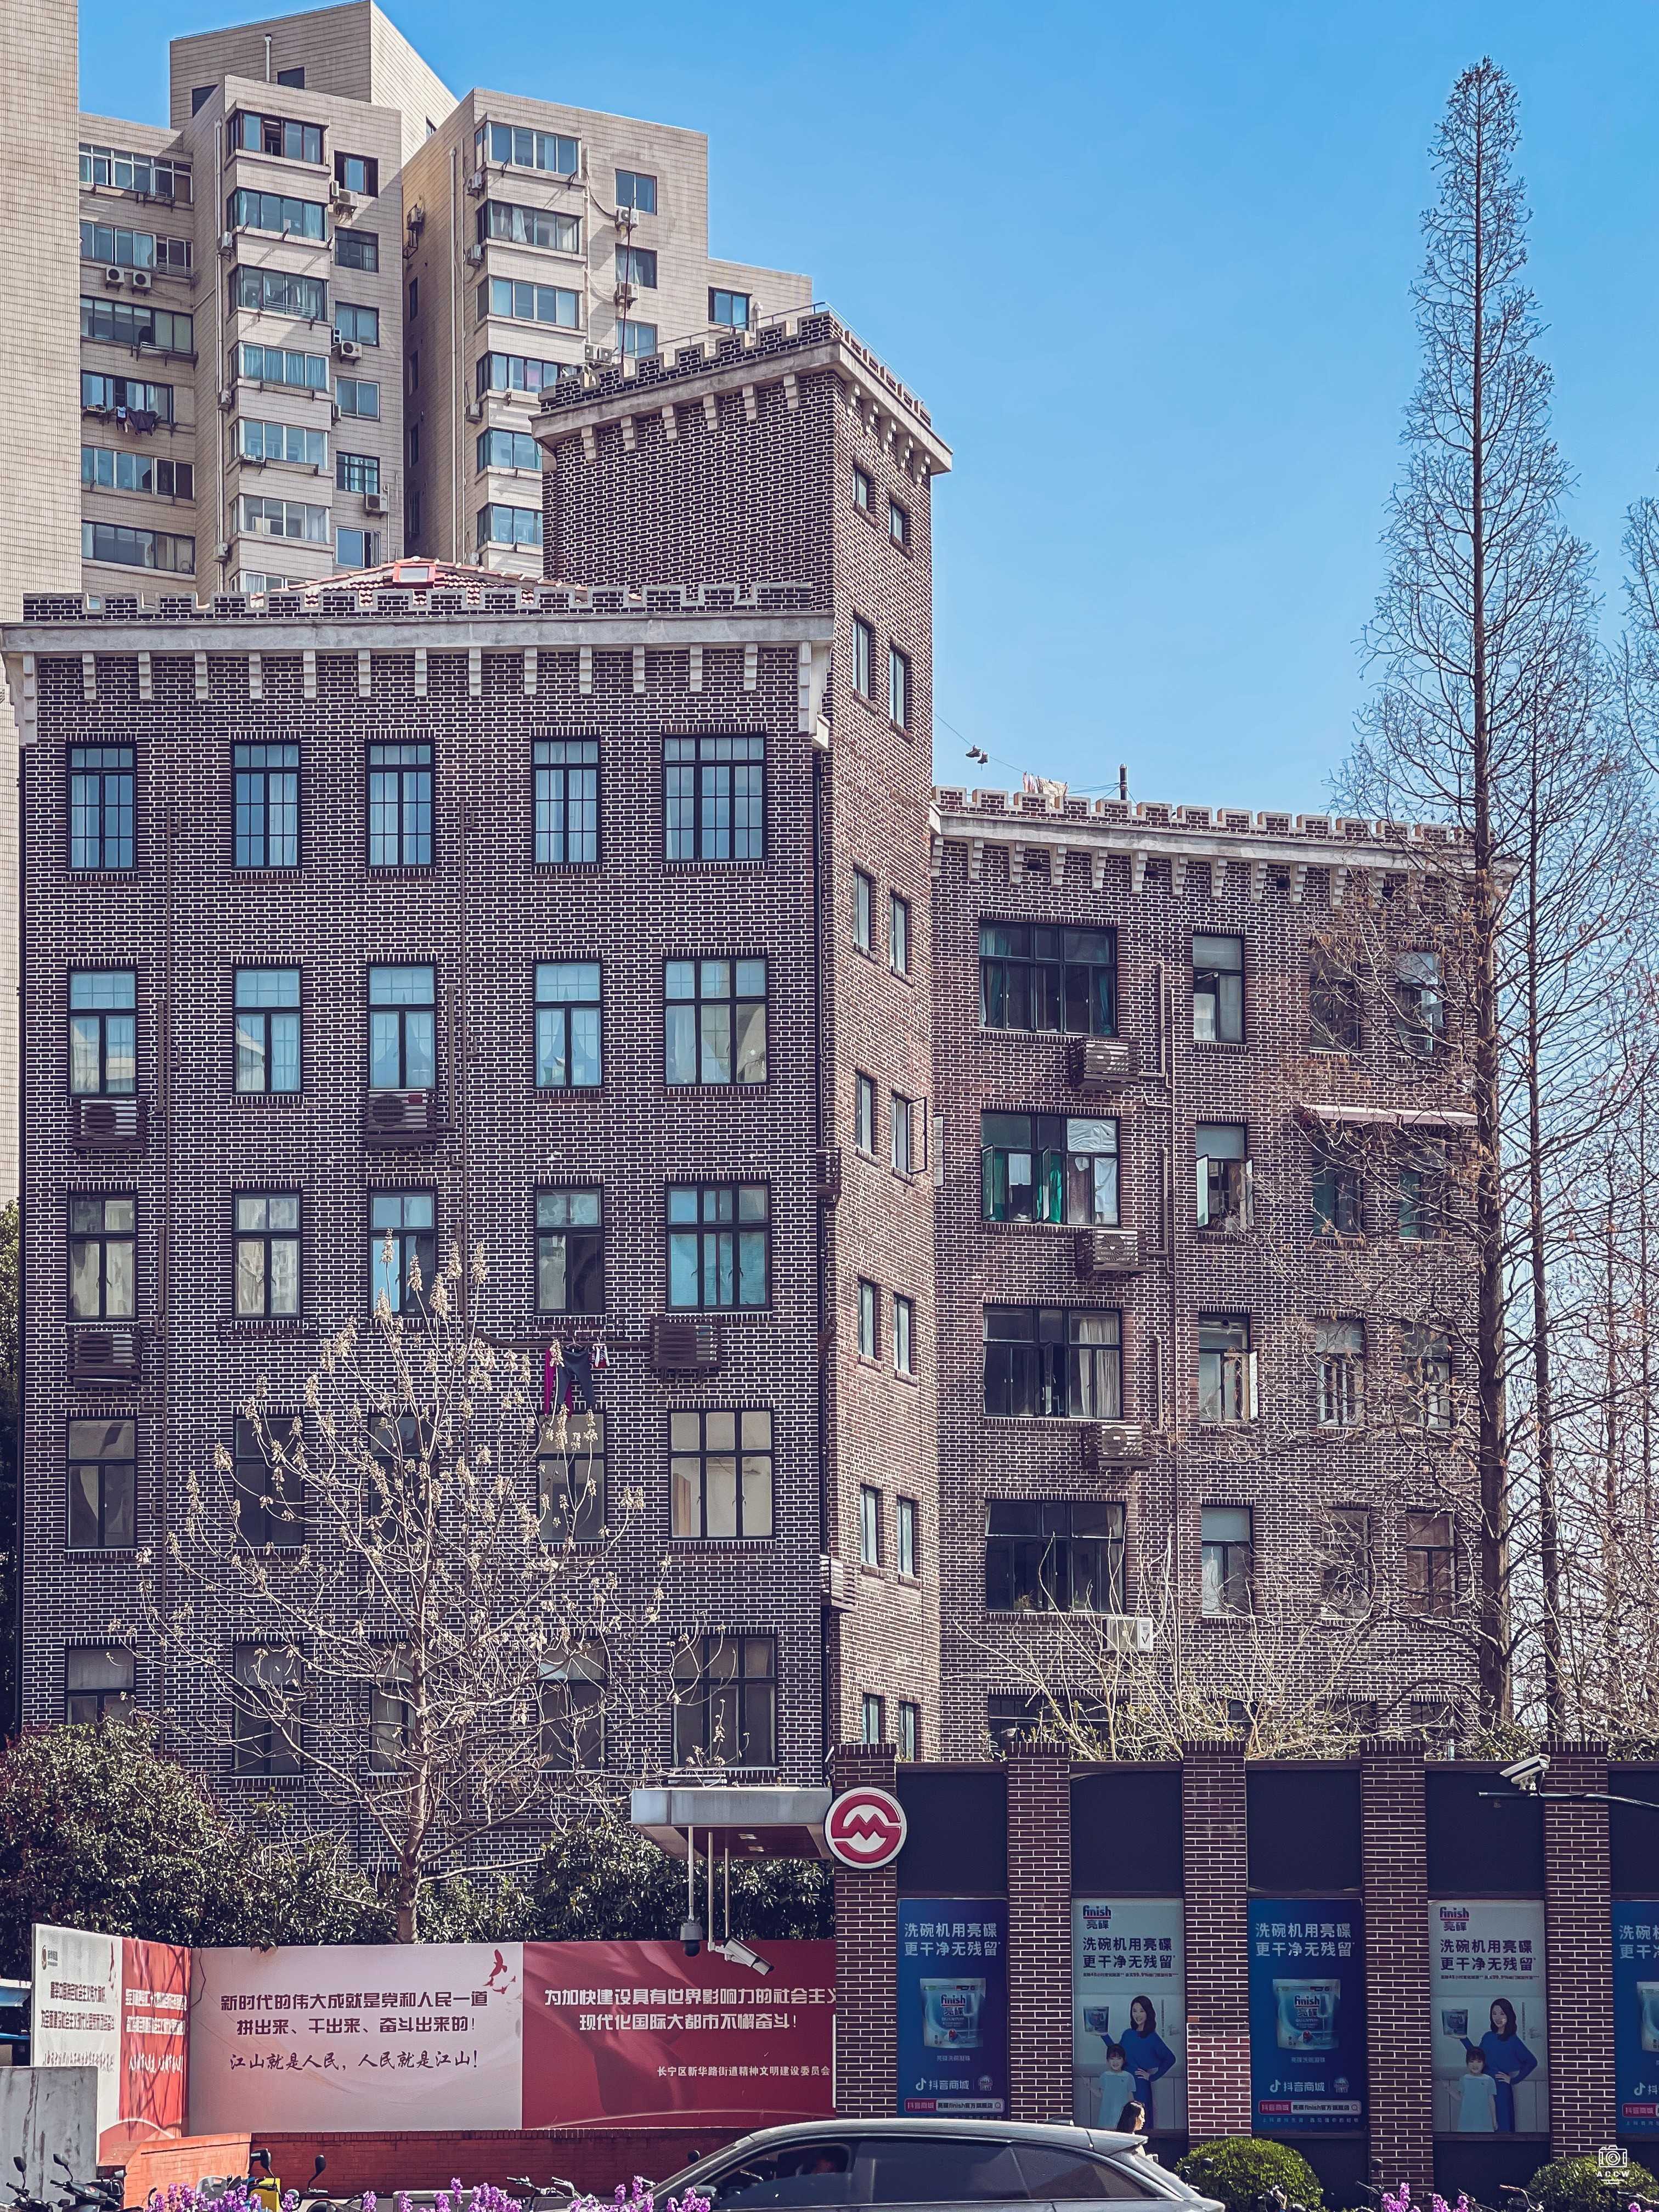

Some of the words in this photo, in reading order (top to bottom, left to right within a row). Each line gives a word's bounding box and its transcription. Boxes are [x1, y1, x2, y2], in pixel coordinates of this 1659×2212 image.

[1083, 1905, 1111, 1916] finish
[1440, 1906, 1470, 1918] finish
[904, 1922, 997, 1938] 洗碗机用亮碟
[1086, 1920, 1109, 1929] 亮碟
[1255, 1922, 1351, 1938] 洗碗机用亮碟
[1443, 1921, 1467, 1931] 亮碟
[904, 1941, 997, 1956] 更干净无残留
[1082, 1937, 1172, 1951] 洗碗机用亮碟
[1256, 1942, 1351, 1957] 更干净无残留
[1440, 1939, 1532, 1954] 洗碗机用亮碟
[1082, 1955, 1172, 1968] 更干净无残留
[1440, 1957, 1533, 1971] 更干净无残留
[221, 1991, 488, 2012] 新时代的伟大成就是党和人民一道
[941, 1994, 966, 2004] finish
[1294, 1995, 1320, 2005] finish
[579, 2013, 797, 2030] 现代化国际大都市不懈奋斗！
[657, 2066, 830, 2077] 长宁区新华路街道精神文明建设委员会
[929, 2080, 969, 2090] 抖音商城
[1283, 2081, 1325, 2092] 抖音商城
